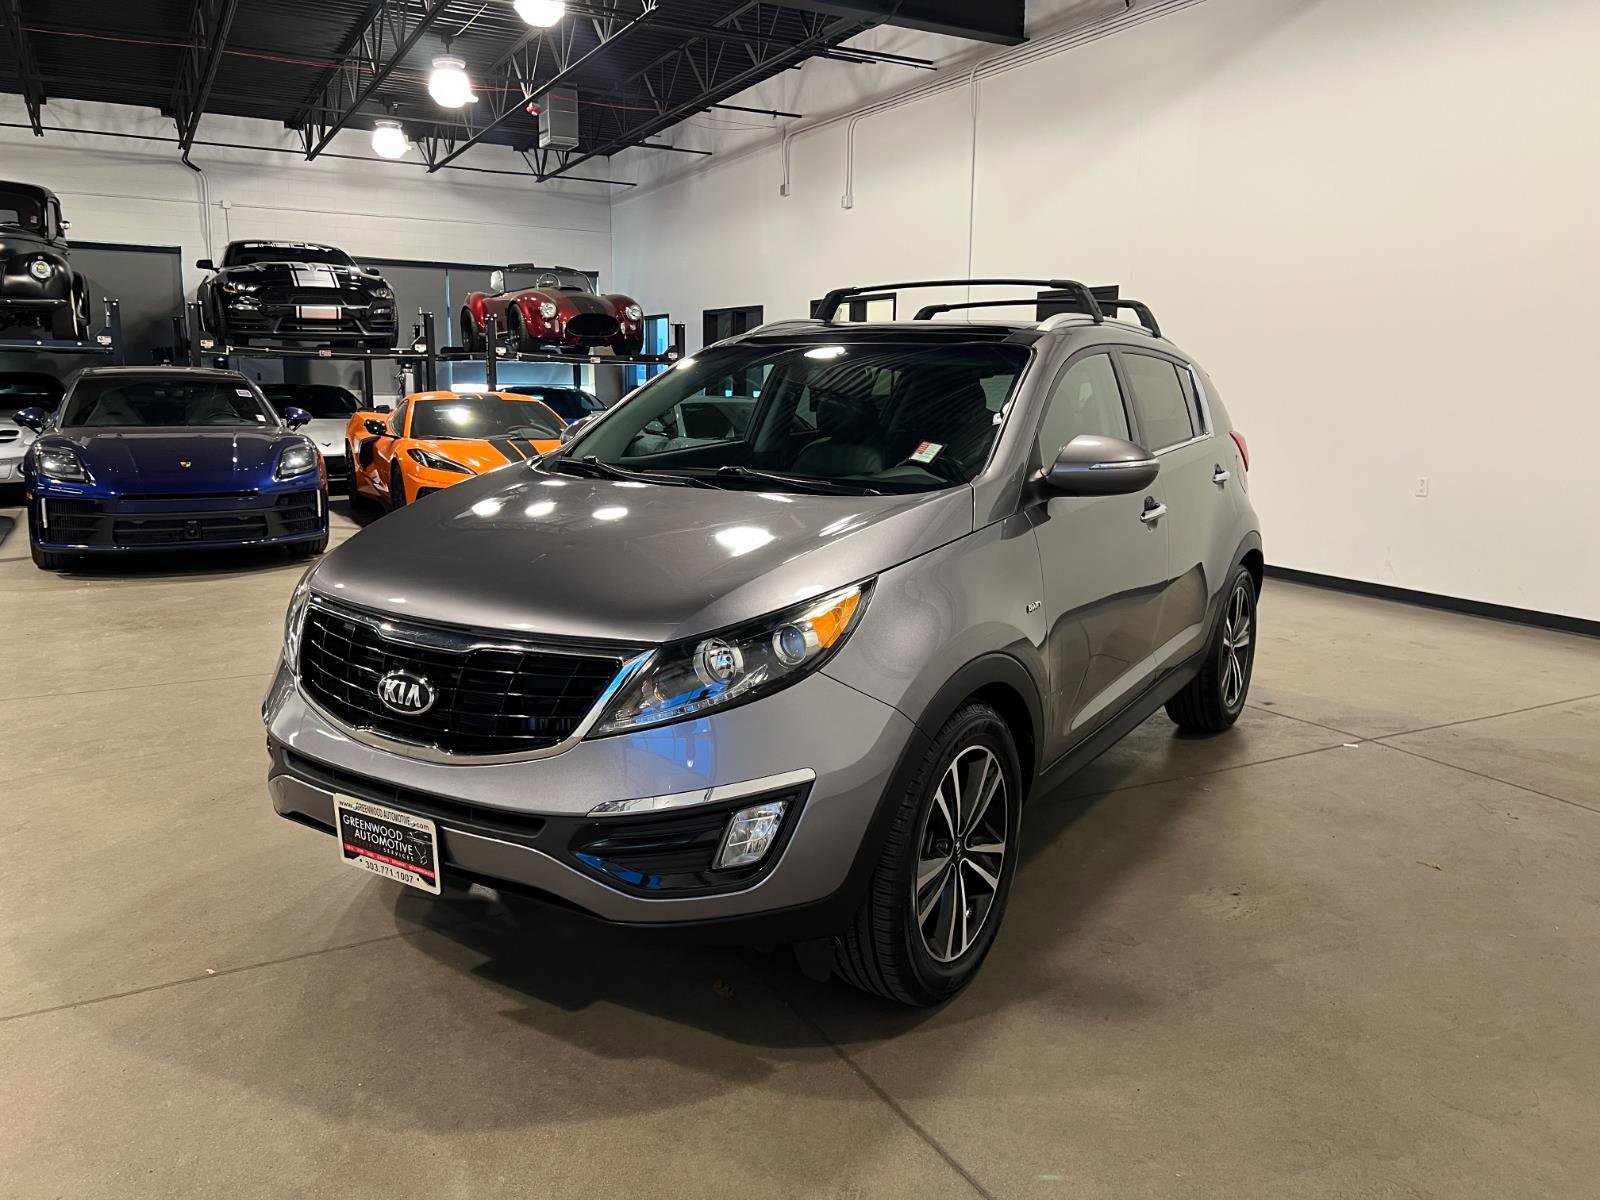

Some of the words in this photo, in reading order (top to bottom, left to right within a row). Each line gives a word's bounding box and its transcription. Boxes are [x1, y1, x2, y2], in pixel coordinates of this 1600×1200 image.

[384, 679, 421, 708] KIA
[342, 814, 403, 841] GREENWOOD
[354, 829, 413, 856] AUTOMOTIVE
[365, 860, 414, 883] 303.771.1007
